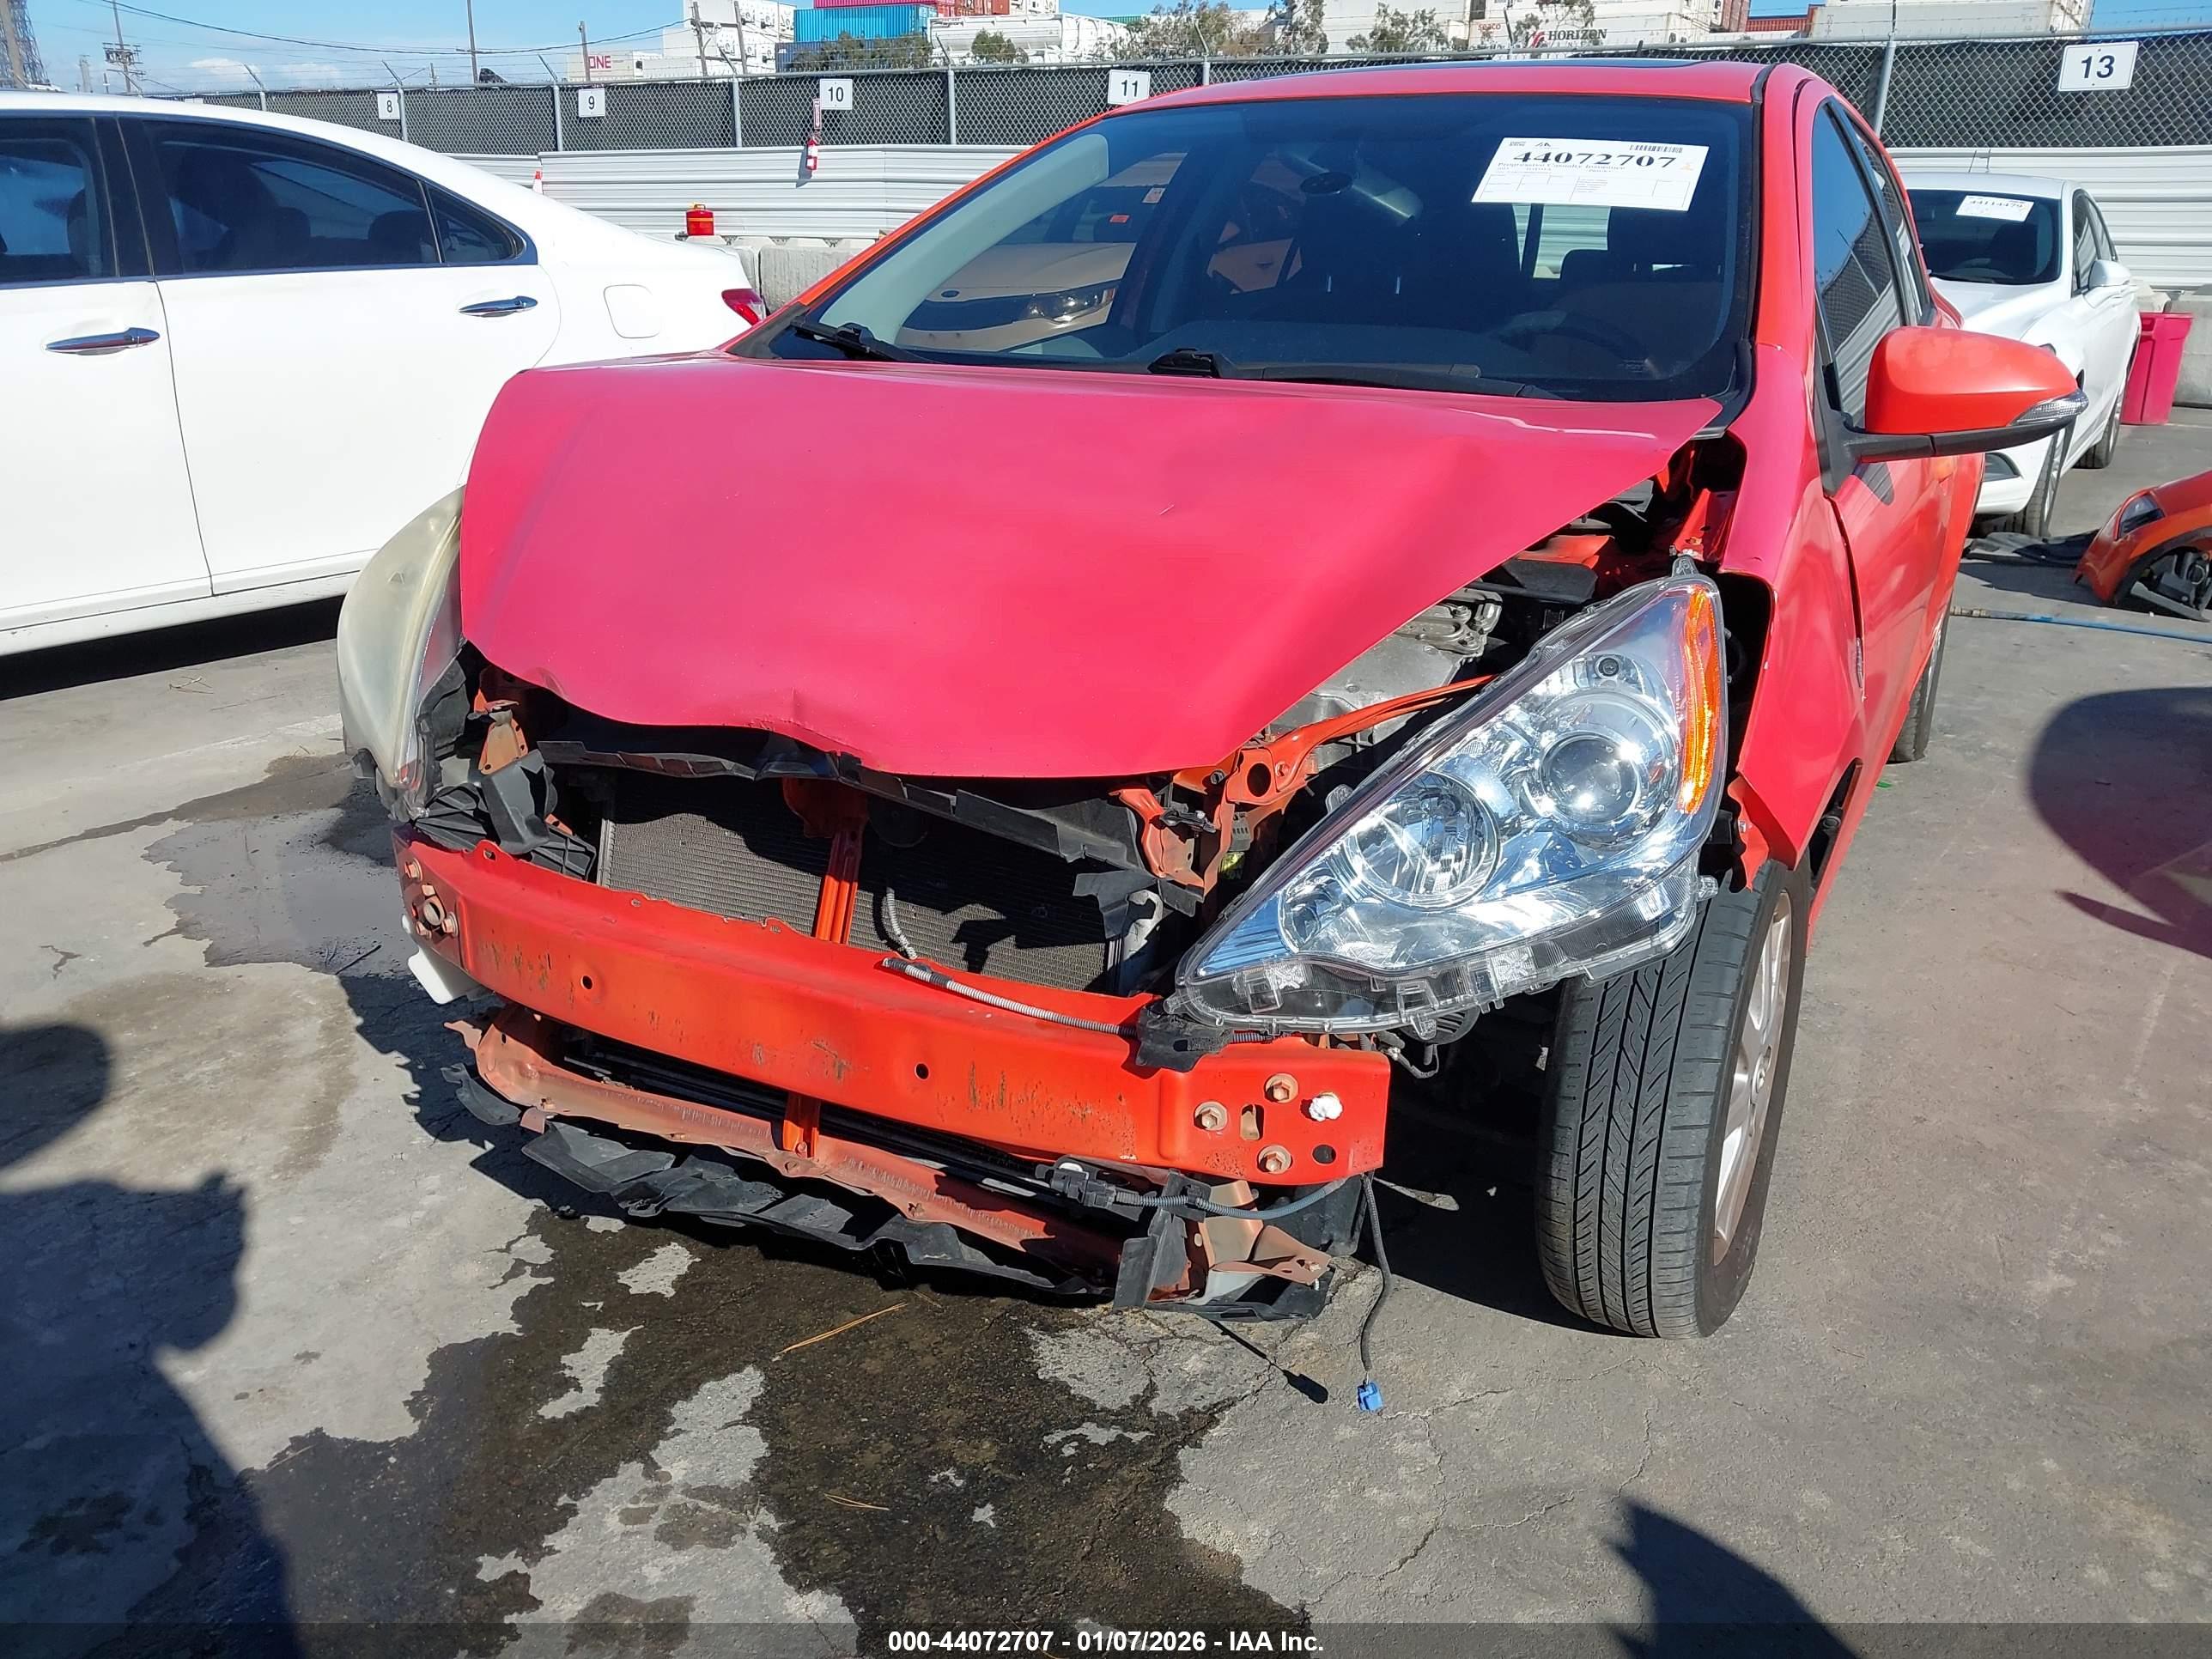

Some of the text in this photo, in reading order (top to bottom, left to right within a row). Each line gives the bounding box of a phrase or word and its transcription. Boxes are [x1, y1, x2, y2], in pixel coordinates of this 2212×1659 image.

[1548, 29, 1607, 40] HORIZON
[588, 56, 611, 69] ONE
[2081, 55, 2115, 79] 13
[828, 87, 844, 102] 10
[1121, 79, 1138, 97] 11
[386, 100, 392, 112] 8
[588, 95, 595, 110] 9
[1513, 151, 1677, 168] 44072707
